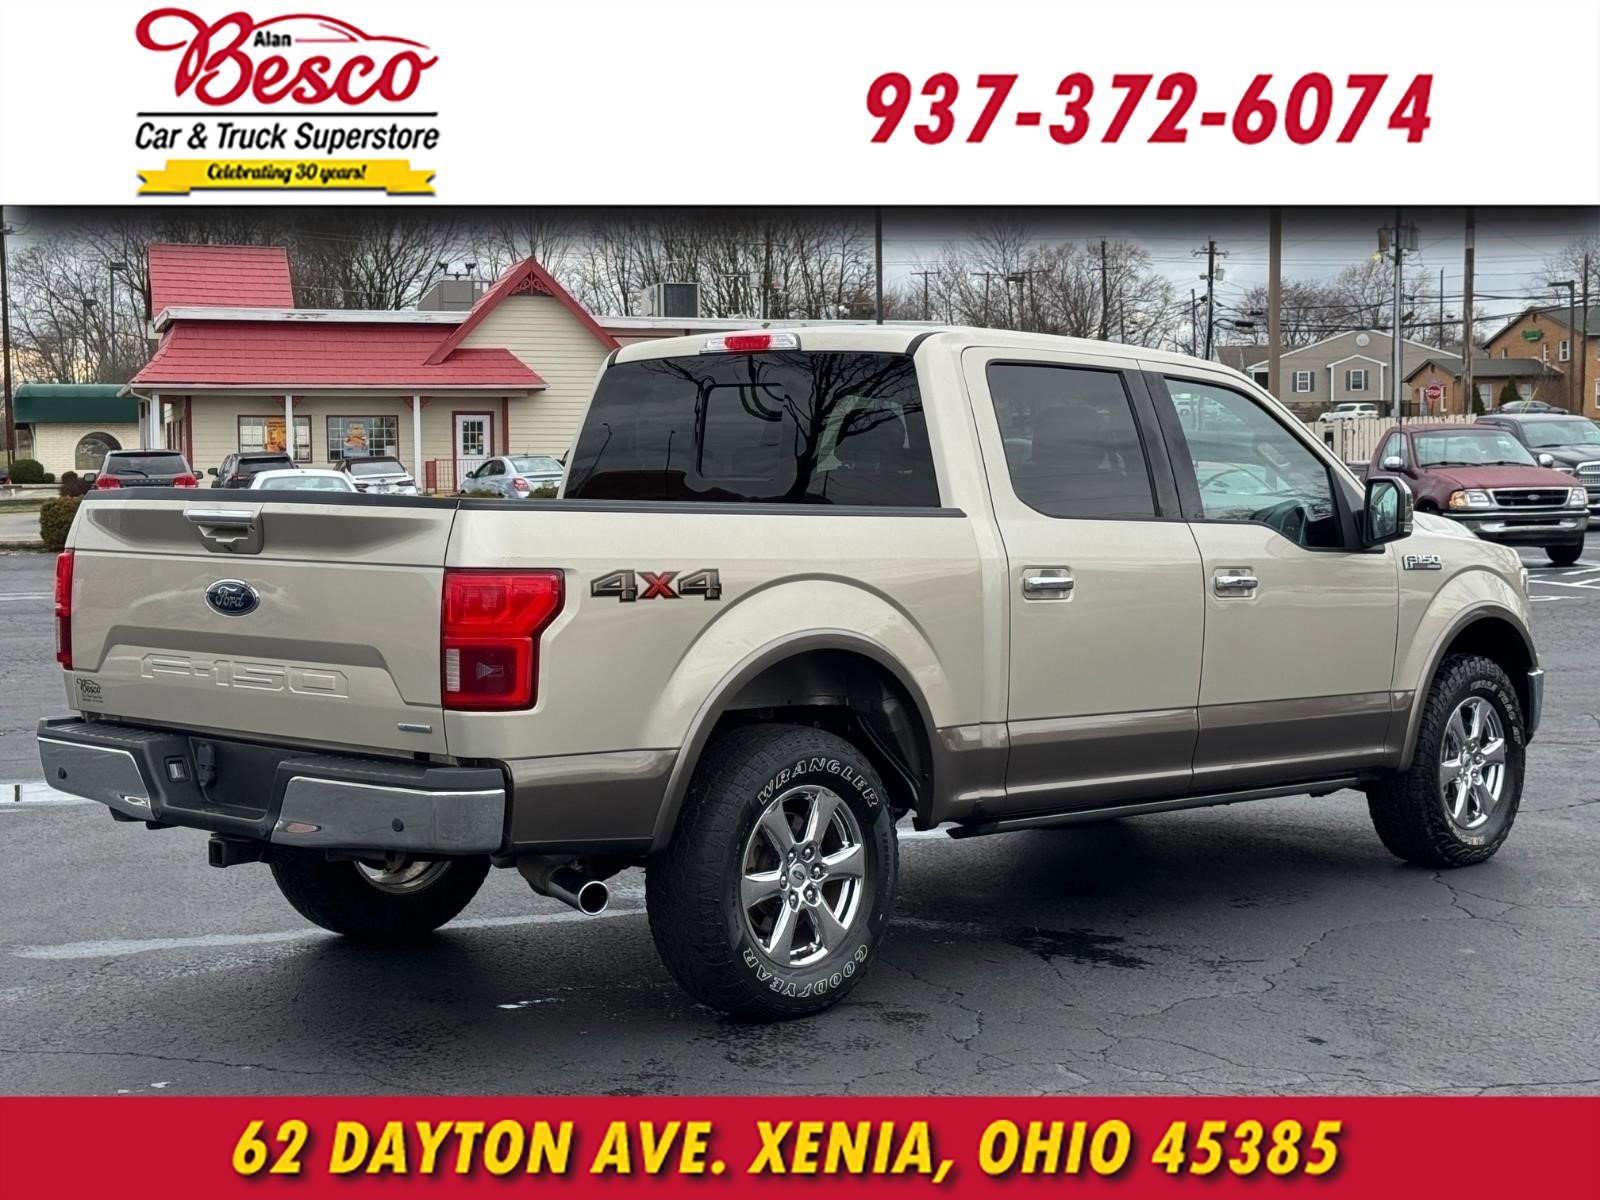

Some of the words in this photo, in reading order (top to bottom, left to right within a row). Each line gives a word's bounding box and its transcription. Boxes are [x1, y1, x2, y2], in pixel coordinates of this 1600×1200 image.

[215, 585, 246, 608] Ford
[140, 652, 349, 699] F-150
[757, 757, 879, 808] WRANGLER
[743, 944, 868, 998] GOODYEAR
